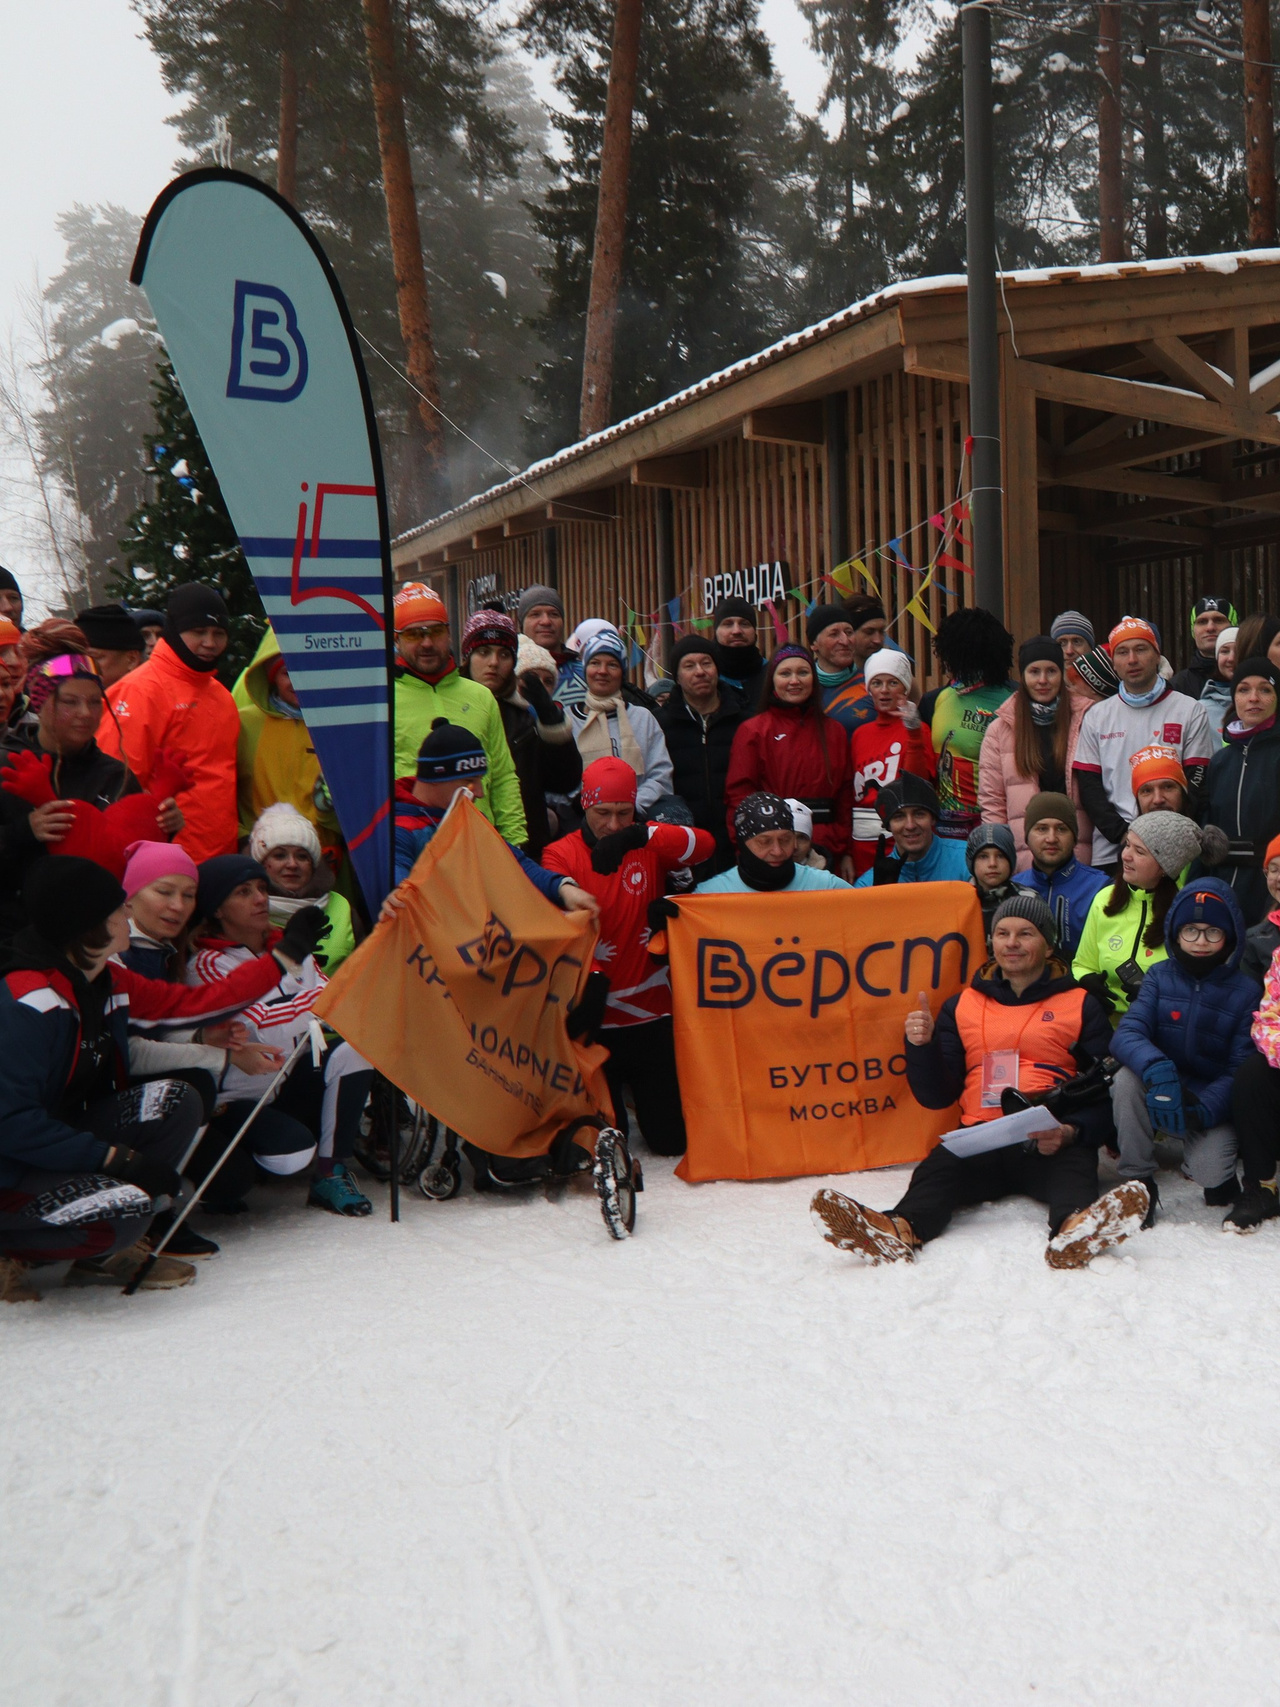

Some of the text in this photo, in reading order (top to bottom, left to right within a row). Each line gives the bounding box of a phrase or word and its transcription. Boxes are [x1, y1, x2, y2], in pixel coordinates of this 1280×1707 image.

[703, 561, 786, 615] ВЕРАНДА
[304, 634, 362, 650] 5verst.ru
[1080, 663, 1107, 691] СПОРТ
[769, 1054, 908, 1089] БУТОВО
[790, 1095, 896, 1122] МОСКВА
